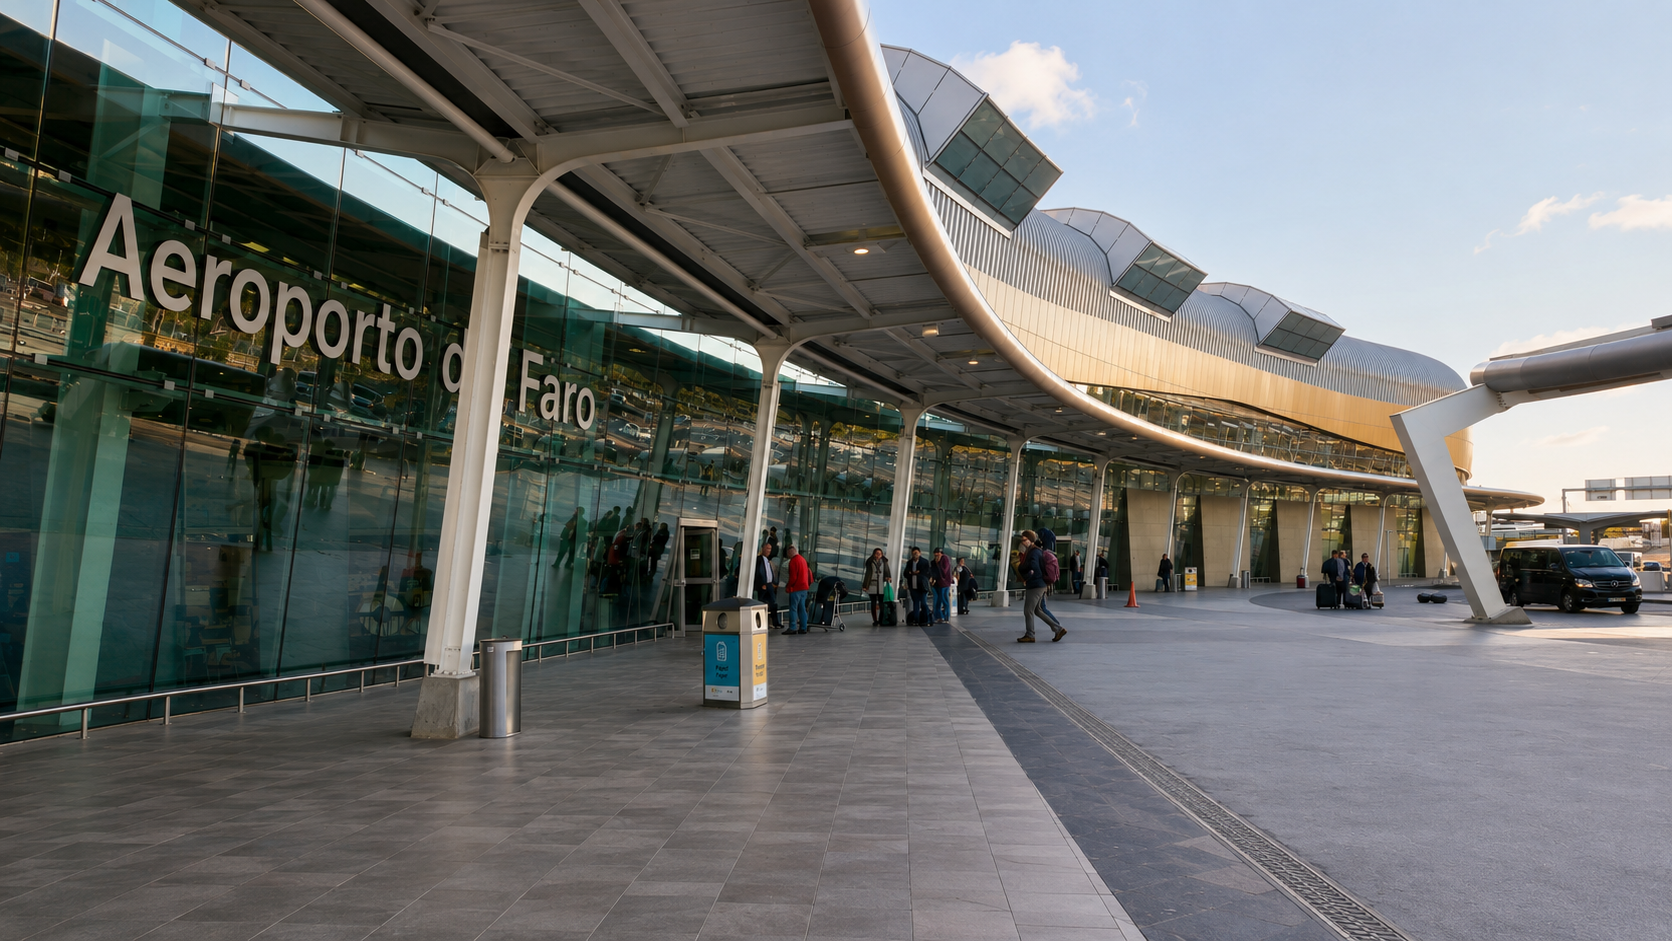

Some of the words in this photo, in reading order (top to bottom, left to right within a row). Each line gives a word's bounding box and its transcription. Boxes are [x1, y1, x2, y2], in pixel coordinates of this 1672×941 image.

[78, 192, 423, 380] Aeroporto
[442, 328, 469, 393] d
[518, 349, 595, 431] Faro
